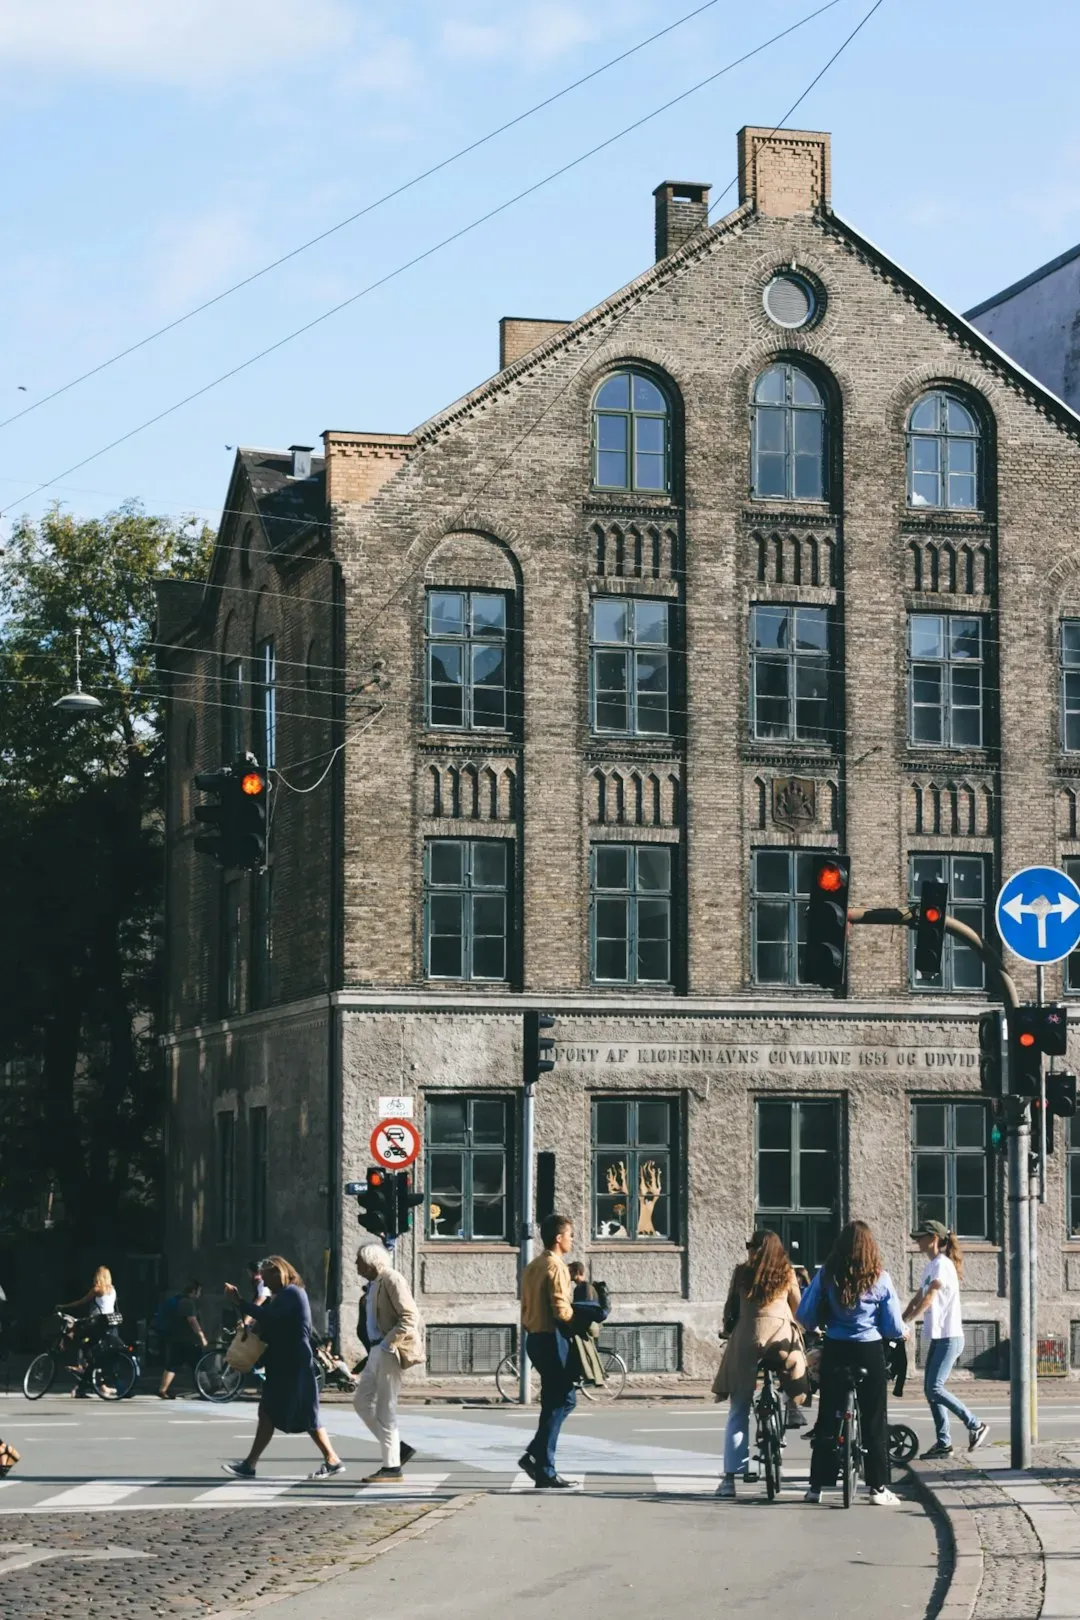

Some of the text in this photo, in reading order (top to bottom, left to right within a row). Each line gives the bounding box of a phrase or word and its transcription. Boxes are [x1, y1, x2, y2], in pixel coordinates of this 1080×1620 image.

[605, 1048, 629, 1063] AF
[768, 1050, 851, 1066] COMMUNE
[896, 1051, 917, 1067] OG
[925, 1052, 981, 1068] UDVID
